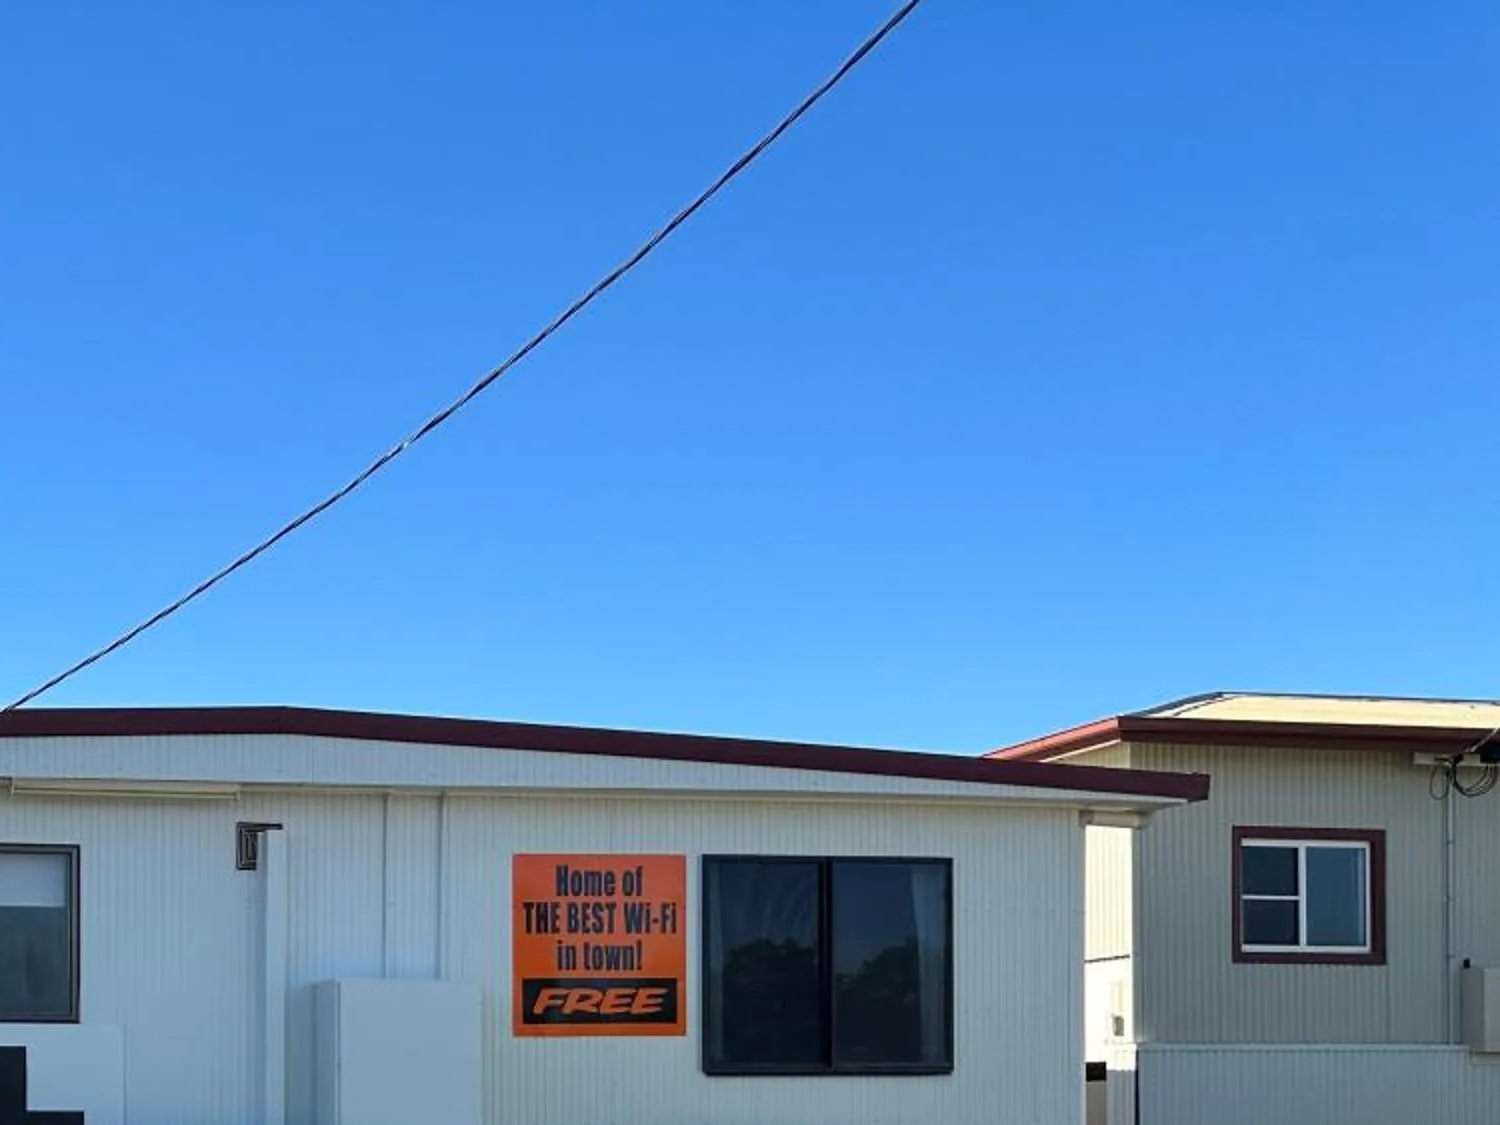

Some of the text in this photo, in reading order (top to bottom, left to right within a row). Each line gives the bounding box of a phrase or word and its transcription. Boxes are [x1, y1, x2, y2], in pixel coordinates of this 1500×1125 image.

[555, 864, 644, 897] Home of
[523, 902, 677, 935] THE BEST Wi-Fi
[556, 940, 643, 971] in town!
[532, 987, 669, 1015] FREE
